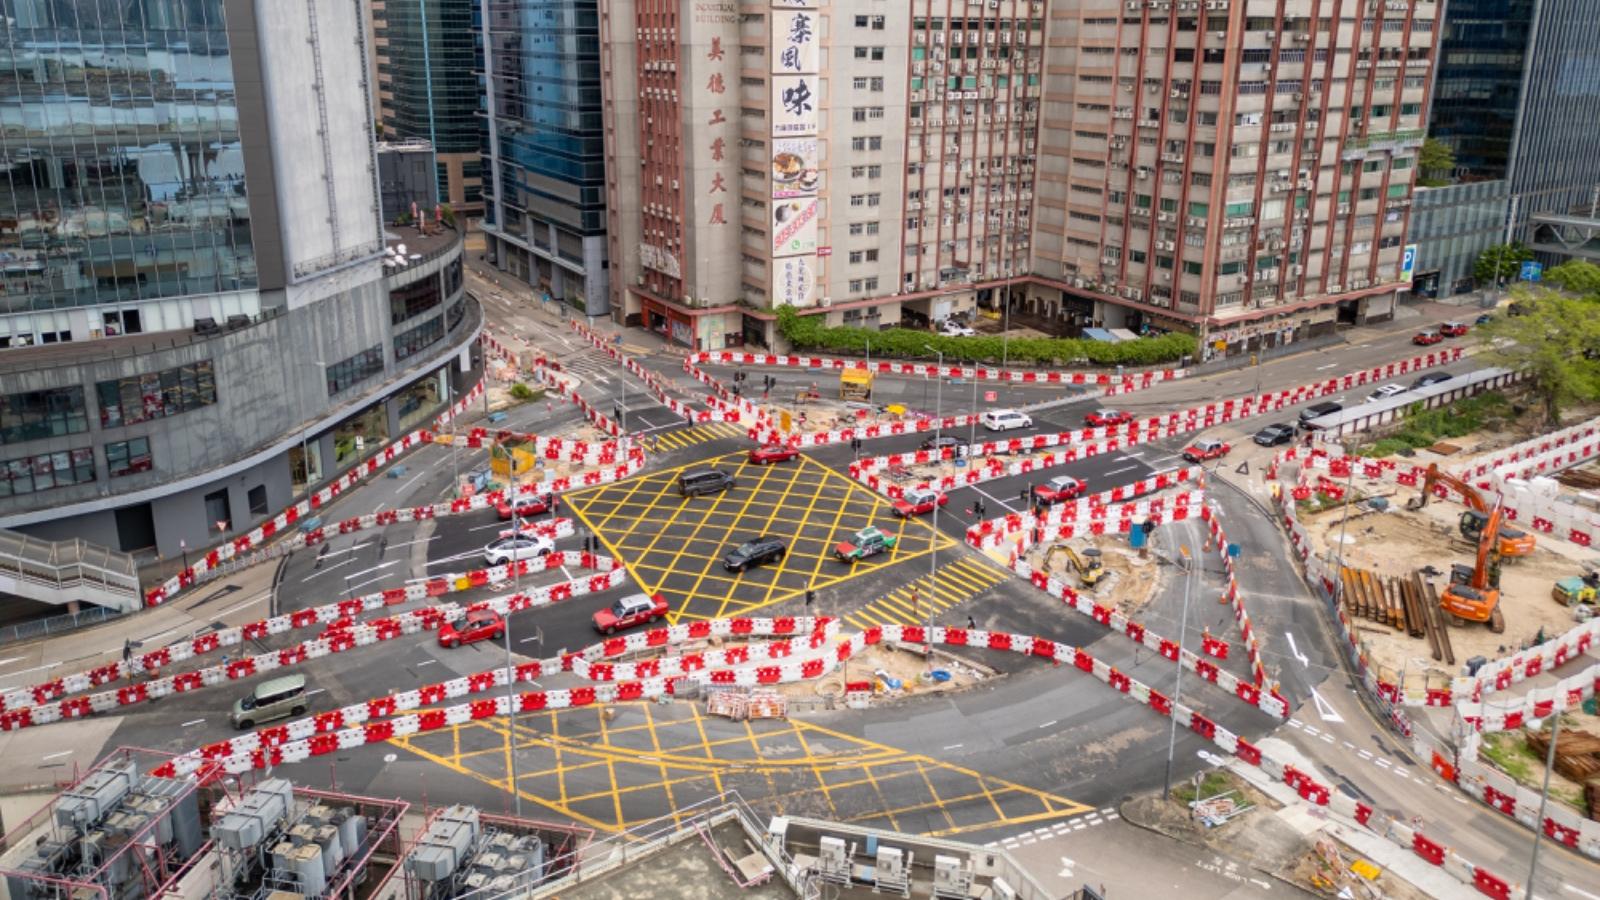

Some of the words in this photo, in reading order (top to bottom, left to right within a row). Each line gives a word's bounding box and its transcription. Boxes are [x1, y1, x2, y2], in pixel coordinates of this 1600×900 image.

[696, 15, 735, 24] BUILDING
[781, 0, 812, 116] 寨風味
[1403, 252, 1411, 269] P
